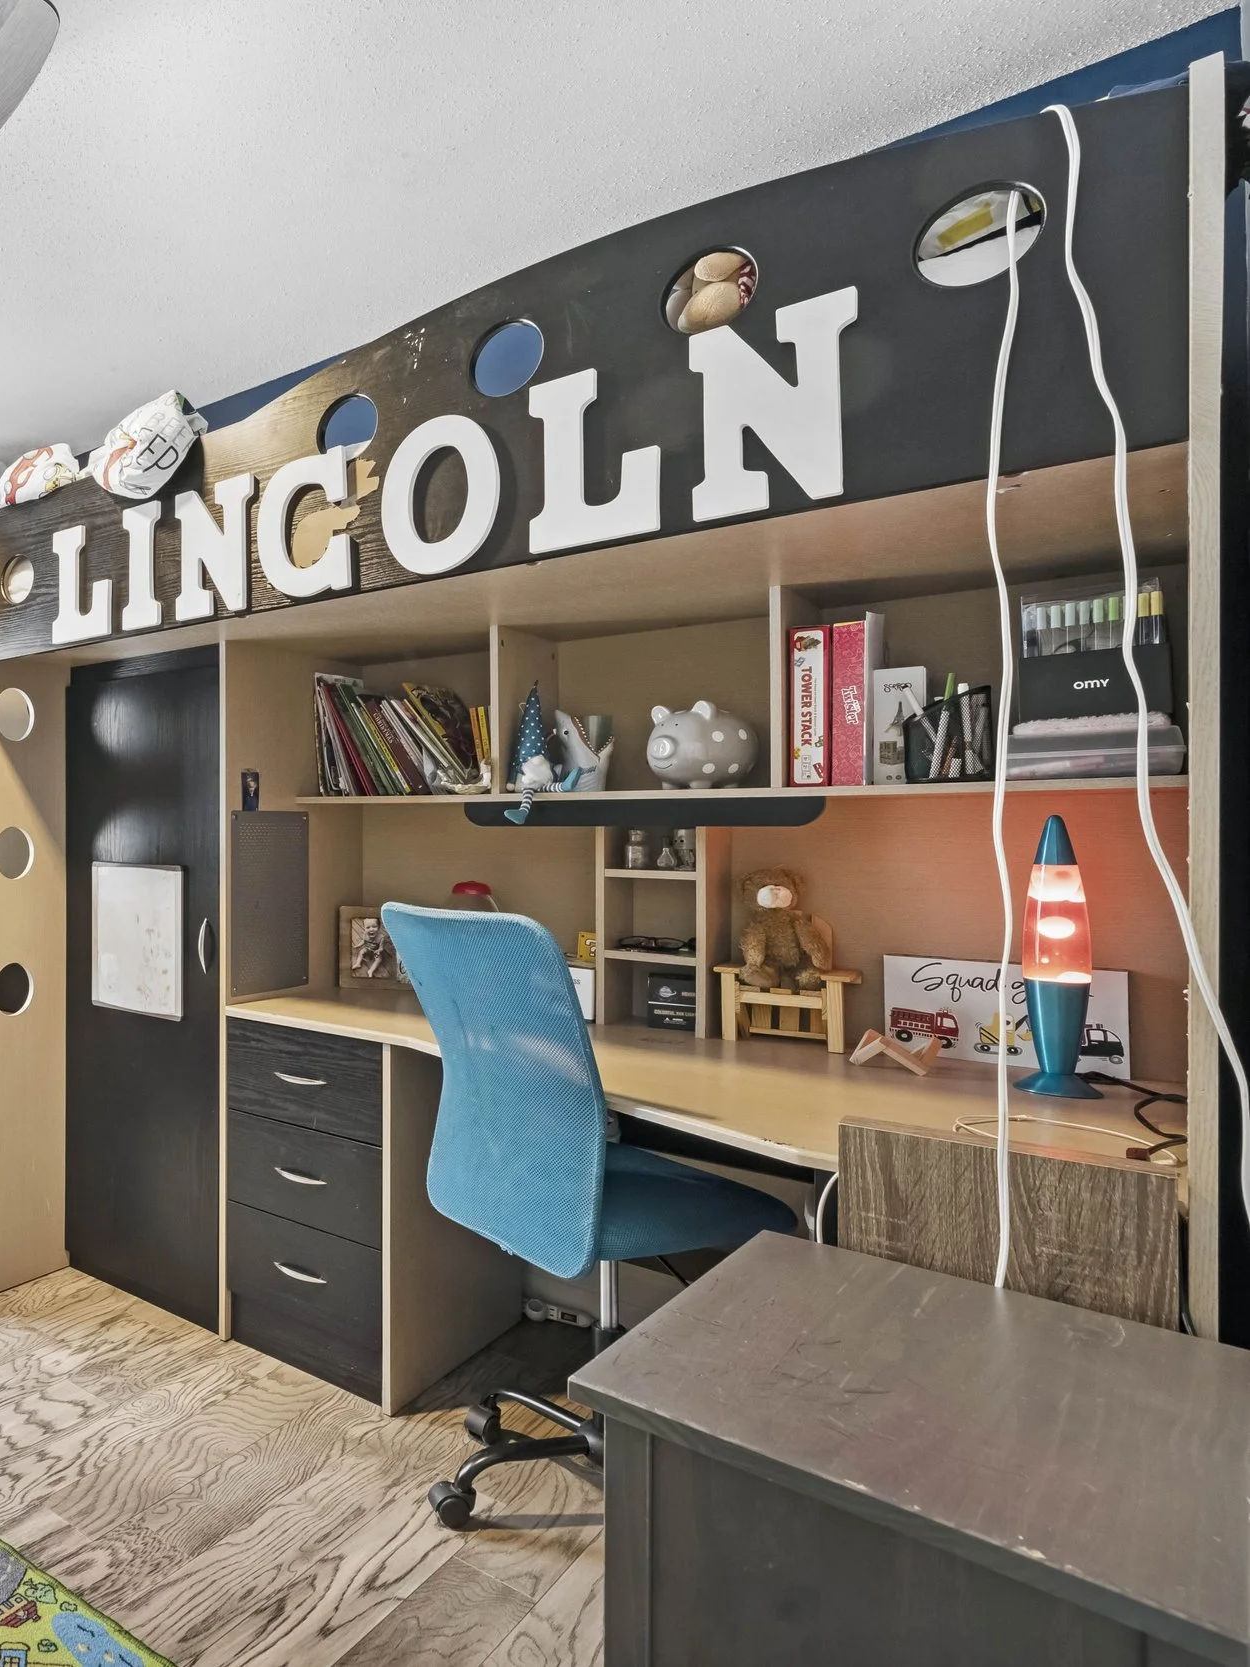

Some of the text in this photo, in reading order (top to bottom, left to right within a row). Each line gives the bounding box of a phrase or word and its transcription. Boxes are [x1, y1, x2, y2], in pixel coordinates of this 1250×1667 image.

[51, 286, 859, 645] LINCOLN
[800, 666, 813, 709] TOWER
[800, 710, 813, 746] STACK
[911, 962, 1001, 1003] Squad
